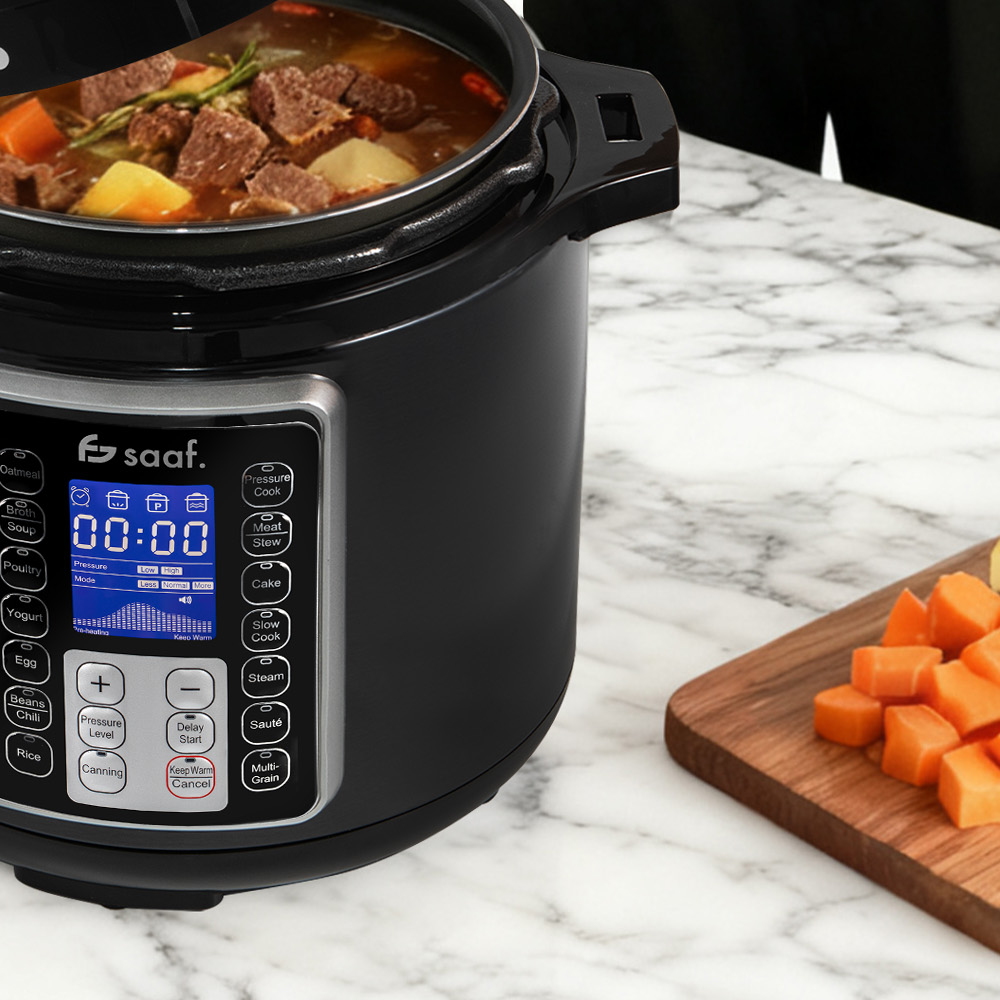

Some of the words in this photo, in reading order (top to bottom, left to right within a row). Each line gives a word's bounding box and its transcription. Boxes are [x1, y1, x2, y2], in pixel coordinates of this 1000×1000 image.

[0, 464, 40, 480] Oatmeal
[244, 474, 291, 485] Pressure
[254, 486, 281, 497] Cook
[6, 504, 35, 518] Broth
[7, 521, 36, 536] Soup
[253, 522, 282, 532] Meat
[73, 514, 208, 556] 00:00
[253, 538, 281, 548] Stew
[3, 561, 42, 577] Poultry
[73, 560, 108, 570] Pressure
[163, 567, 180, 575] High
[74, 575, 96, 584] Mode
[252, 579, 281, 589] Cake
[6, 607, 44, 622] Yogurt
[252, 620, 280, 630] Slow
[251, 631, 281, 642] Cook
[15, 655, 37, 669] Egg
[248, 672, 284, 682] Steam
[10, 694, 46, 709] Beans
[16, 710, 41, 722] Chili
[81, 715, 122, 728] Pressure
[177, 722, 204, 734] Delay
[250, 718, 283, 730] Sauté
[89, 728, 114, 739] Level
[179, 735, 202, 744] Start
[17, 748, 41, 762] Rice
[82, 764, 123, 779] Canning
[169, 766, 190, 776] Keep
[191, 766, 213, 775] Warm
[251, 762, 280, 773] Multi-
[172, 779, 211, 789] Cancel
[251, 774, 280, 784] Grain
